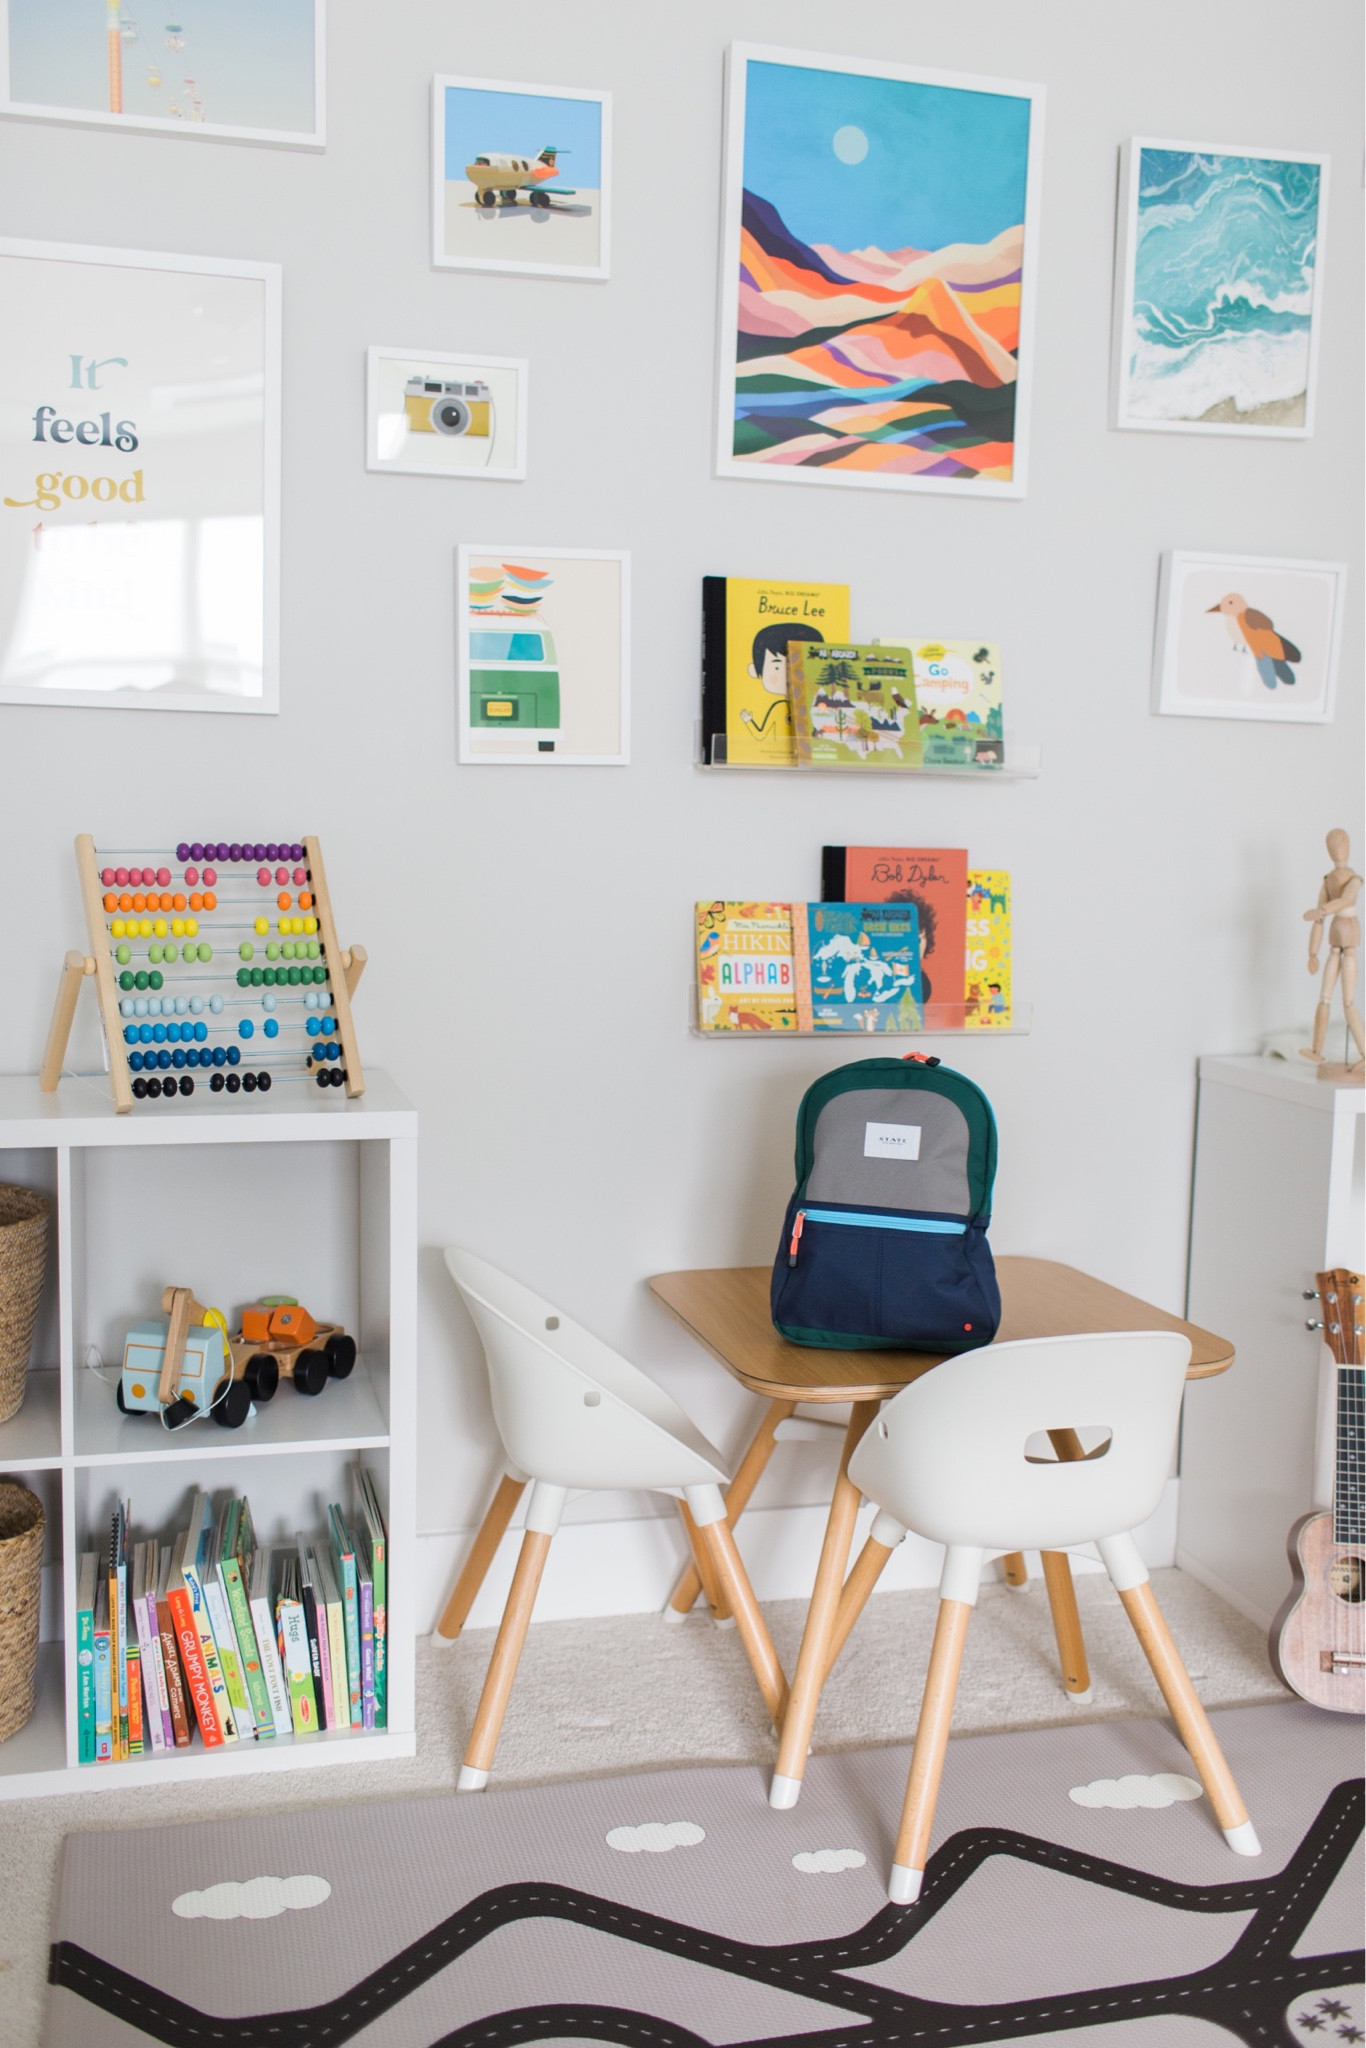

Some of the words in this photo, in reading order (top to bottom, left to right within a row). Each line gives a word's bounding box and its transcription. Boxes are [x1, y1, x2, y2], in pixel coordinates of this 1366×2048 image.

[68, 355, 128, 390] It
[32, 406, 139, 452] feels
[4, 469, 146, 511] good
[758, 596, 798, 615] Bruce
[803, 600, 825, 617] Lee
[913, 674, 969, 694] Camping
[928, 664, 948, 676] Go
[871, 863, 903, 883] Bob
[907, 864, 950, 888] Dylan
[723, 934, 791, 951] HIKIN
[722, 962, 790, 985] ALPHAB
[288, 1614, 300, 1643] Hugs
[160, 1632, 177, 1659] ANSEL
[165, 1659, 182, 1687] ADAMS
[200, 1634, 224, 1694] ANIMALS
[181, 1630, 204, 1679] GRUMPY
[194, 1682, 217, 1731] MONKEY
[170, 1687, 181, 1719] camera
